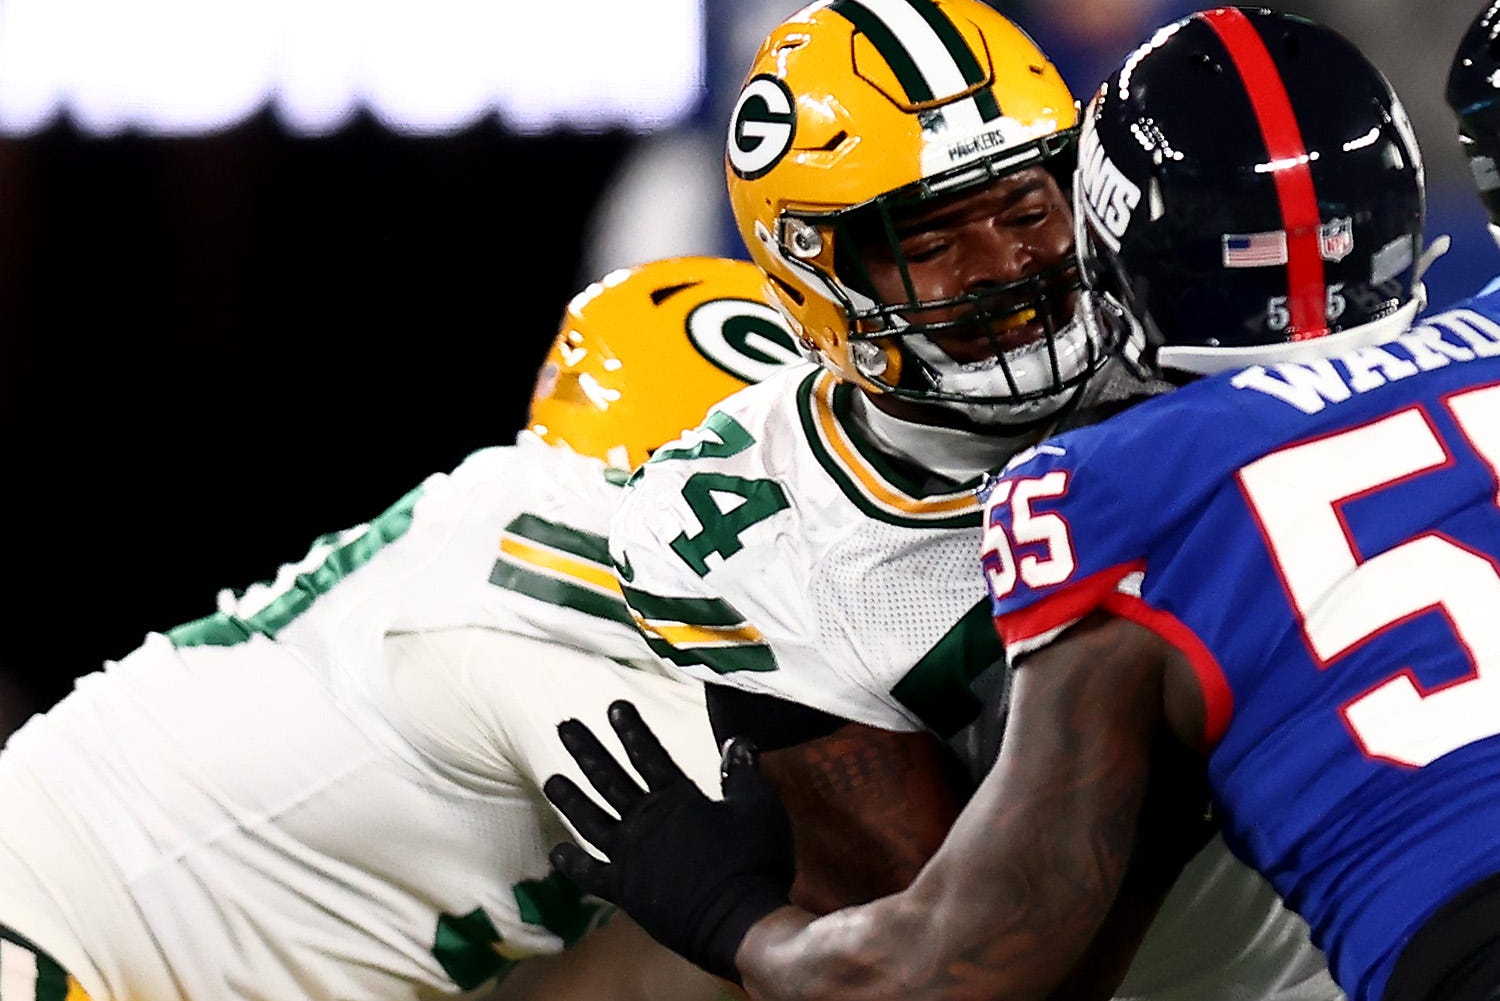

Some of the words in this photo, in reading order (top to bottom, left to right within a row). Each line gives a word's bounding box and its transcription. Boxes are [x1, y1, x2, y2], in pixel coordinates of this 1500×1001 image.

[728, 79, 791, 172] G
[946, 130, 1005, 161] PACKERS
[981, 470, 1079, 600] 55
